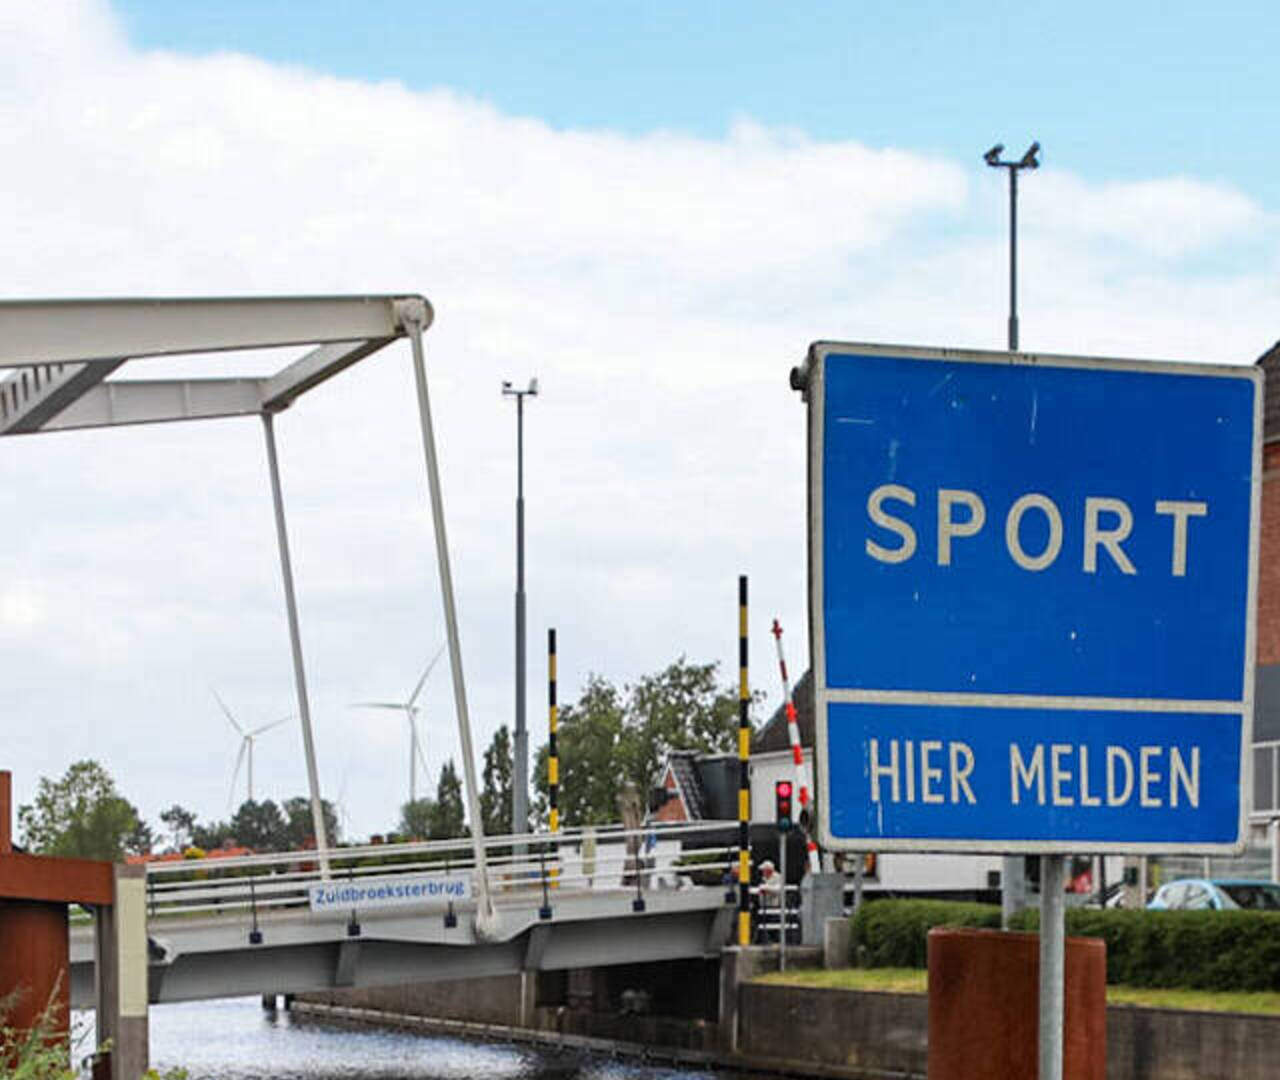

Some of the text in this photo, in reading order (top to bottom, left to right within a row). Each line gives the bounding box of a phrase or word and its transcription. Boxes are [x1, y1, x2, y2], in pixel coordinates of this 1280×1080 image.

[865, 483, 1208, 577] SPORT
[869, 738, 1200, 808] HIER MELDEN
[316, 880, 465, 905] Zuidbroeksterbrug
